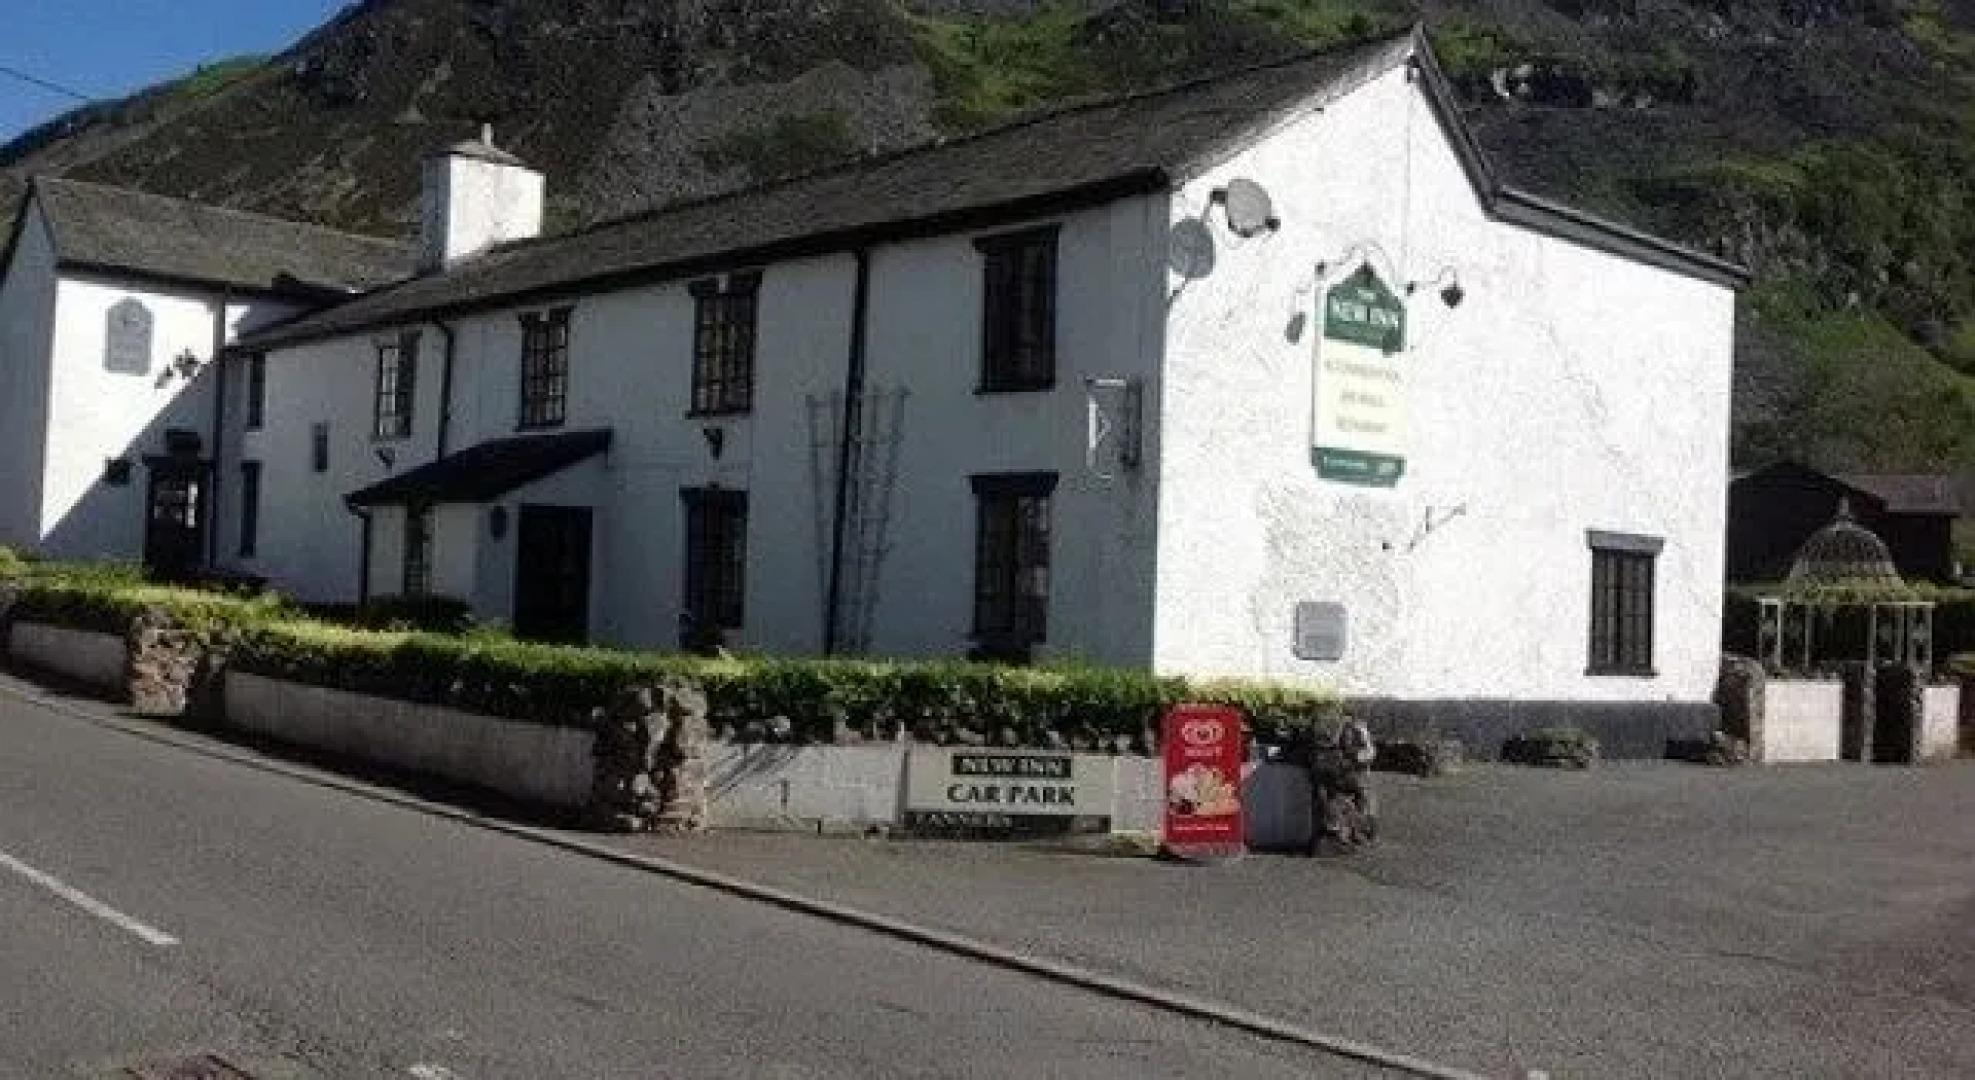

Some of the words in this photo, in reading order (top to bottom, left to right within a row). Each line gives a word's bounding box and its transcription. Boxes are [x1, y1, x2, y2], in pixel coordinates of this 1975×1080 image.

[961, 757, 1013, 773] NEW
[1020, 758, 1064, 775] INN
[947, 784, 1001, 802] CAR
[1008, 786, 1074, 805] PARK
